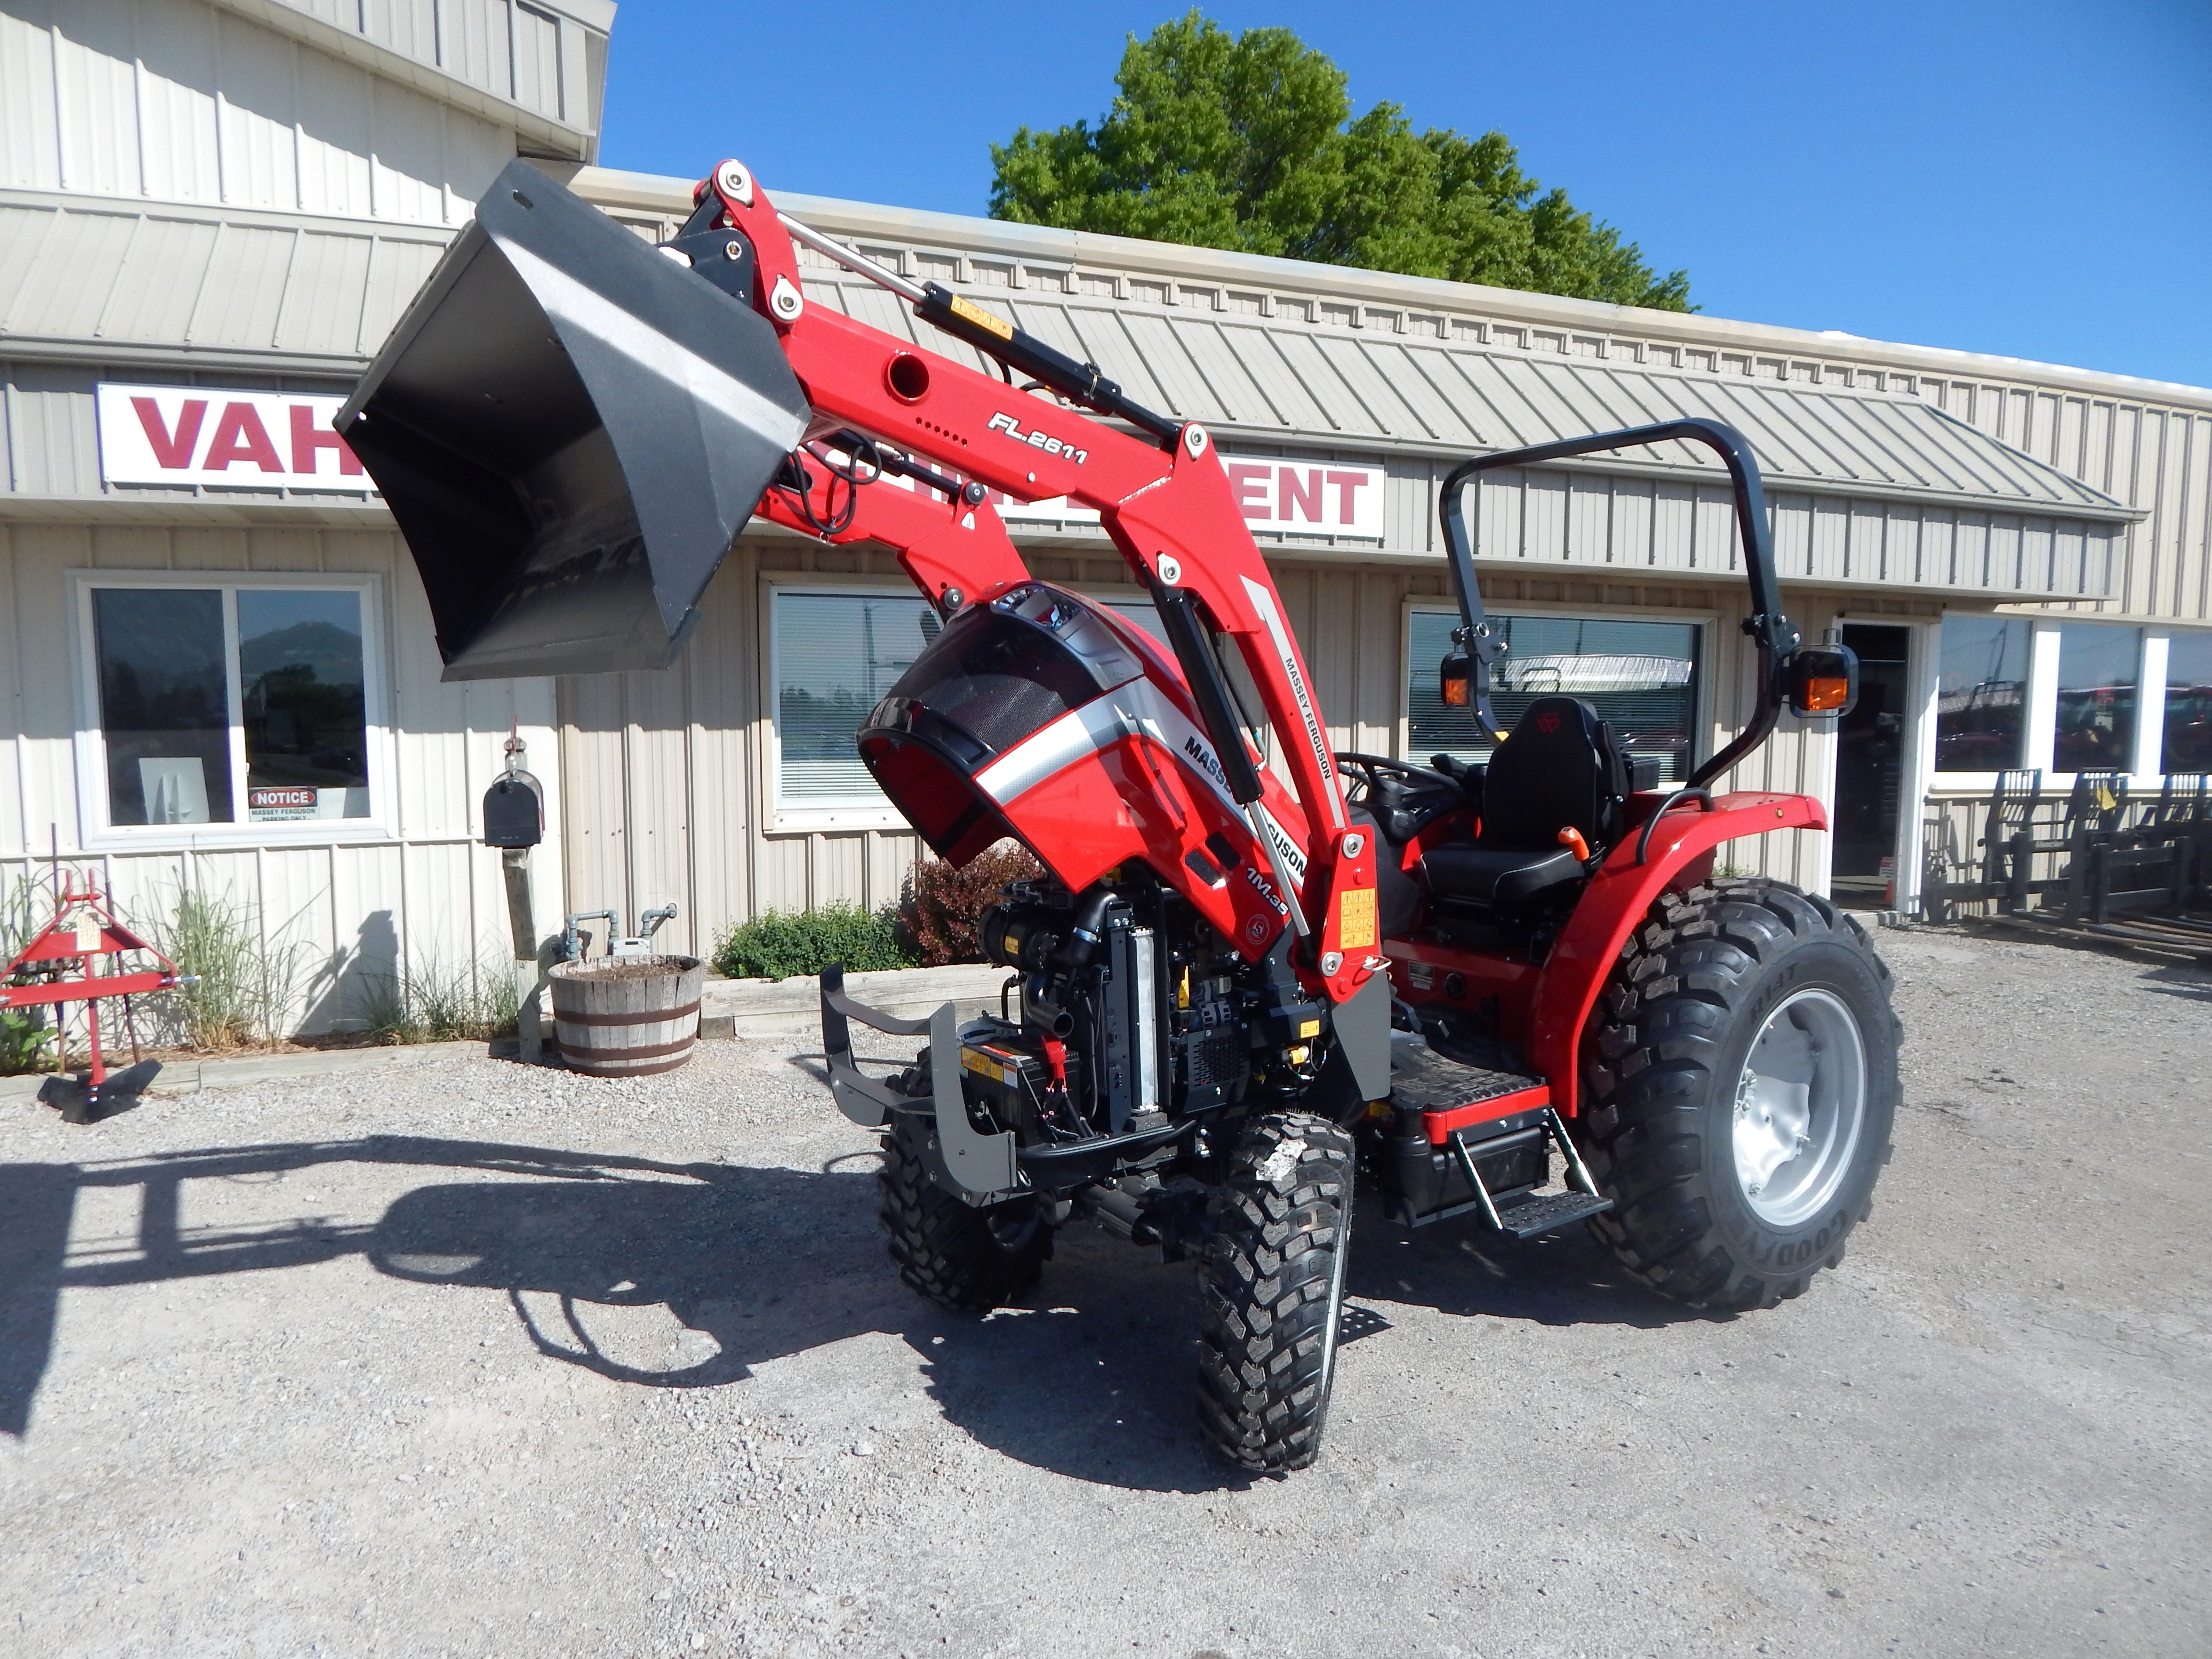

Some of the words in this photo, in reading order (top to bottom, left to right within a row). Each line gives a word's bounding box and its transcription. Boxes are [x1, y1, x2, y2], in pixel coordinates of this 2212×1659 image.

[987, 411, 1088, 465] FL.2611
[1286, 658, 1309, 709] MASSEY
[1305, 712, 1331, 780] FERGUSON
[258, 792, 309, 804] NOTICE
[1247, 867, 1289, 916] 1M.35
